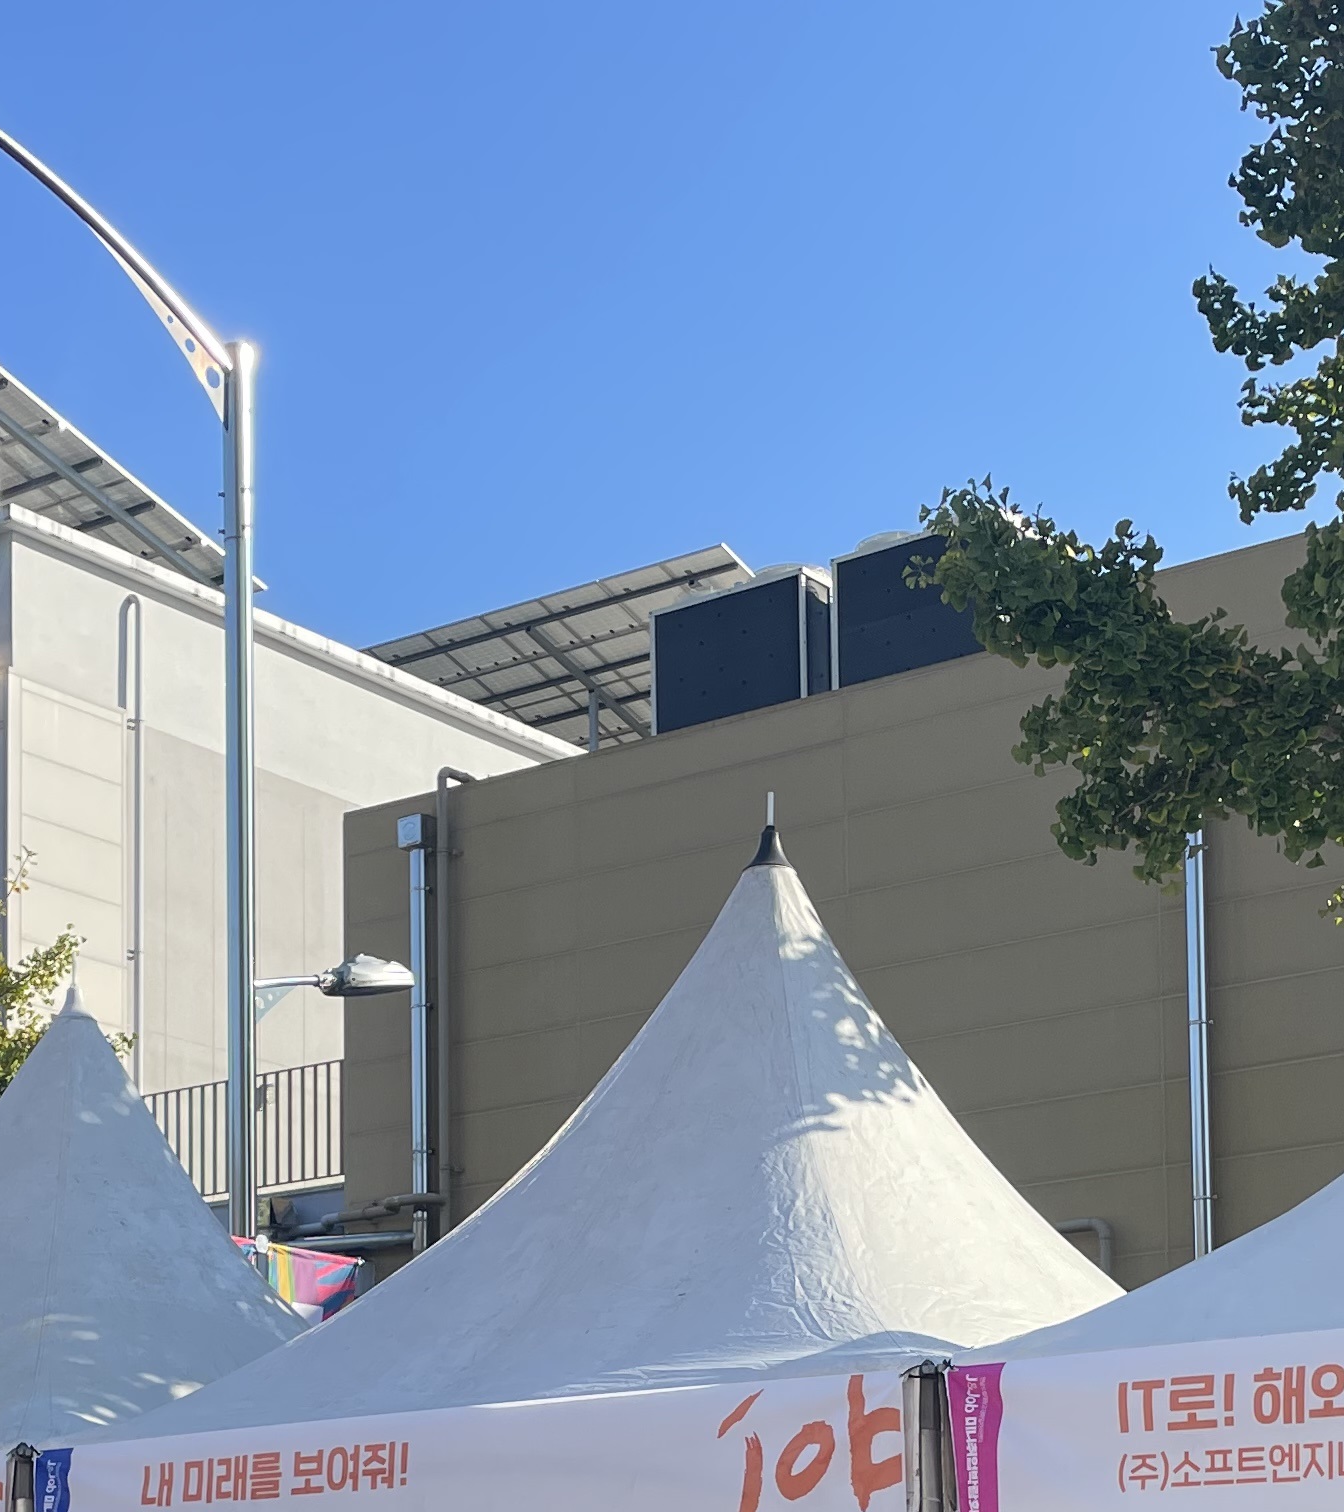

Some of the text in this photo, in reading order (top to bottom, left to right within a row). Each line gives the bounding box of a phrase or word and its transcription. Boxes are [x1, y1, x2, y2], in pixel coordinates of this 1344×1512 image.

[1117, 1372, 1235, 1434] IT로!
[139, 1441, 410, 1509] 내 미래를 보여줘!
